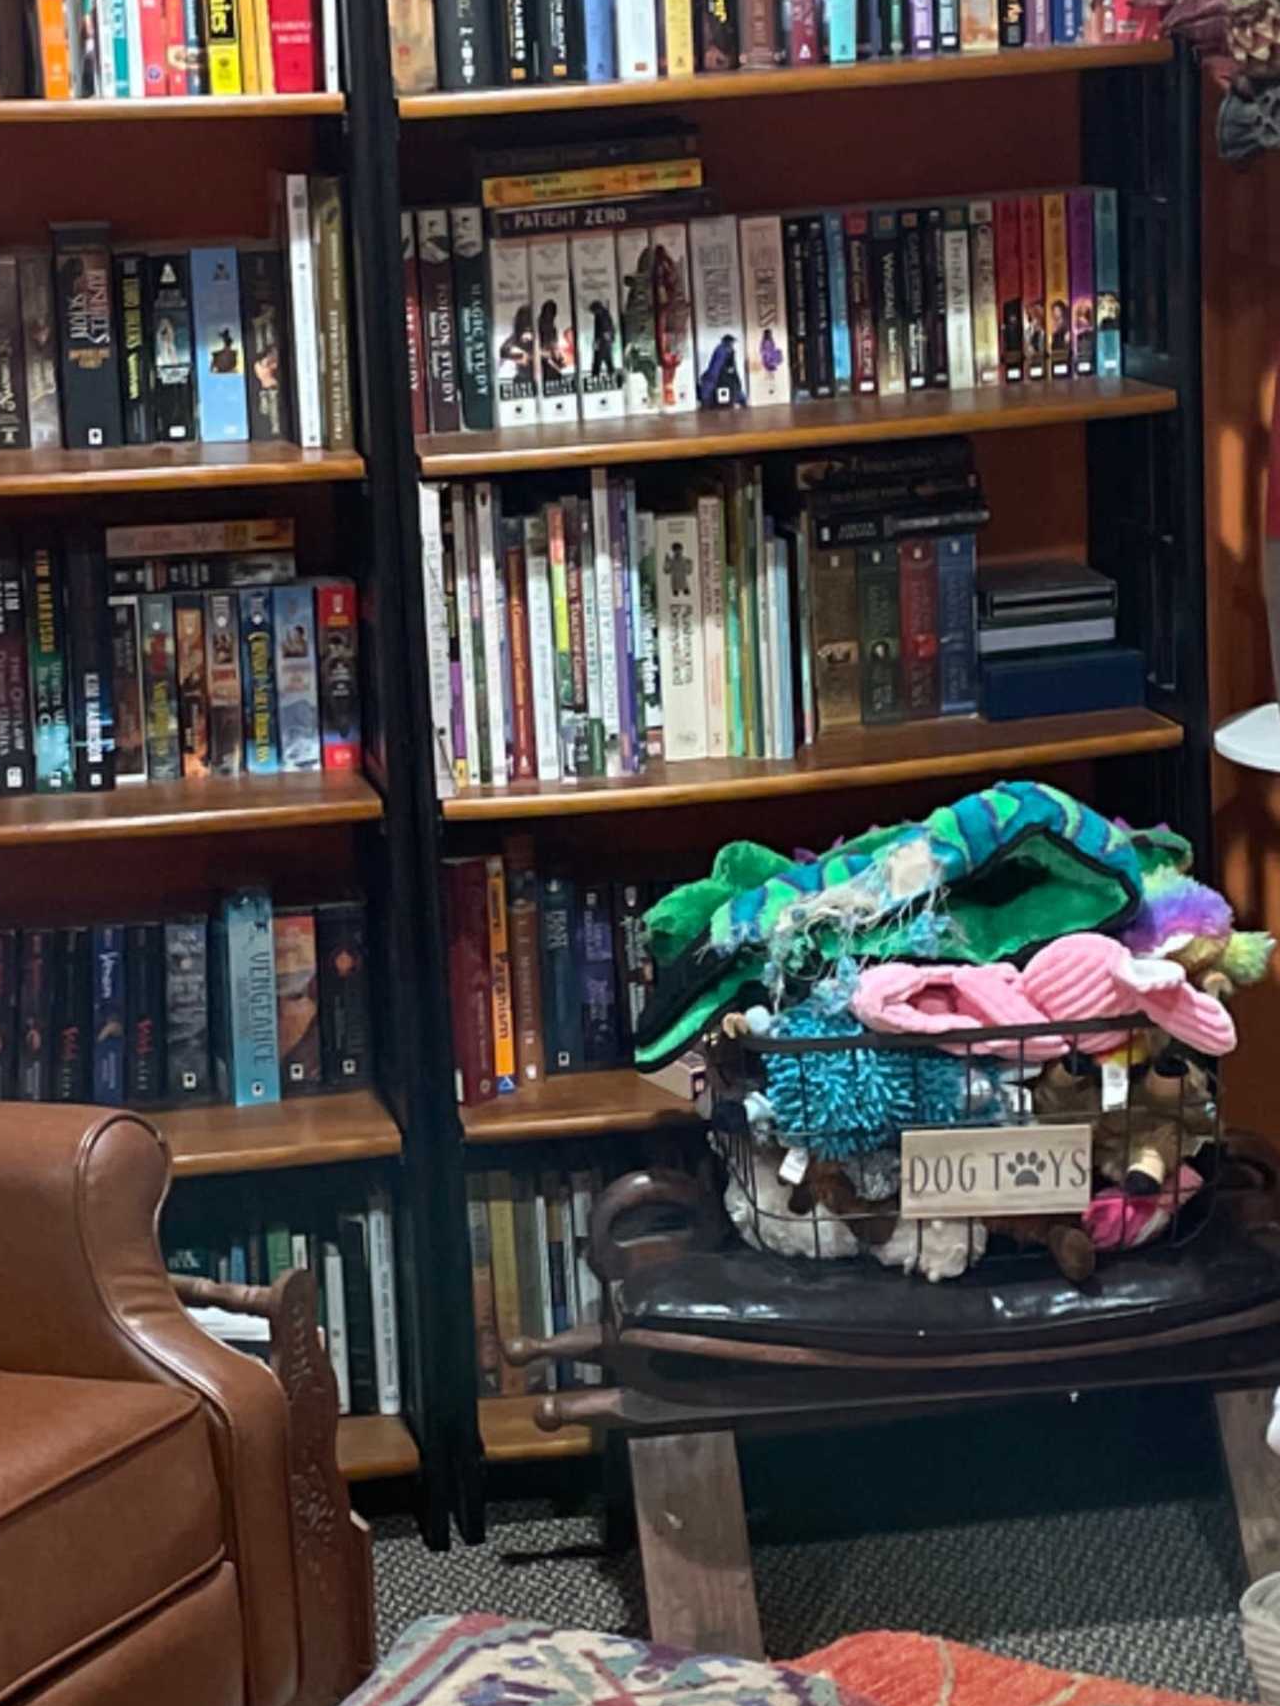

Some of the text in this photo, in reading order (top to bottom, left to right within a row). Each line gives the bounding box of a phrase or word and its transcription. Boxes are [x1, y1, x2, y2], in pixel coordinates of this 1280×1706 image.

[514, 205, 627, 228] PATIENT ZERO
[438, 350, 455, 403] STUDY
[471, 340, 488, 396] STUDY
[3, 579, 18, 611] KIM
[33, 549, 55, 654] KIM HARRISON
[82, 671, 106, 764] KIM HARRISON
[249, 950, 274, 1066] VENGEANCE
[909, 1153, 977, 1195] DOG
